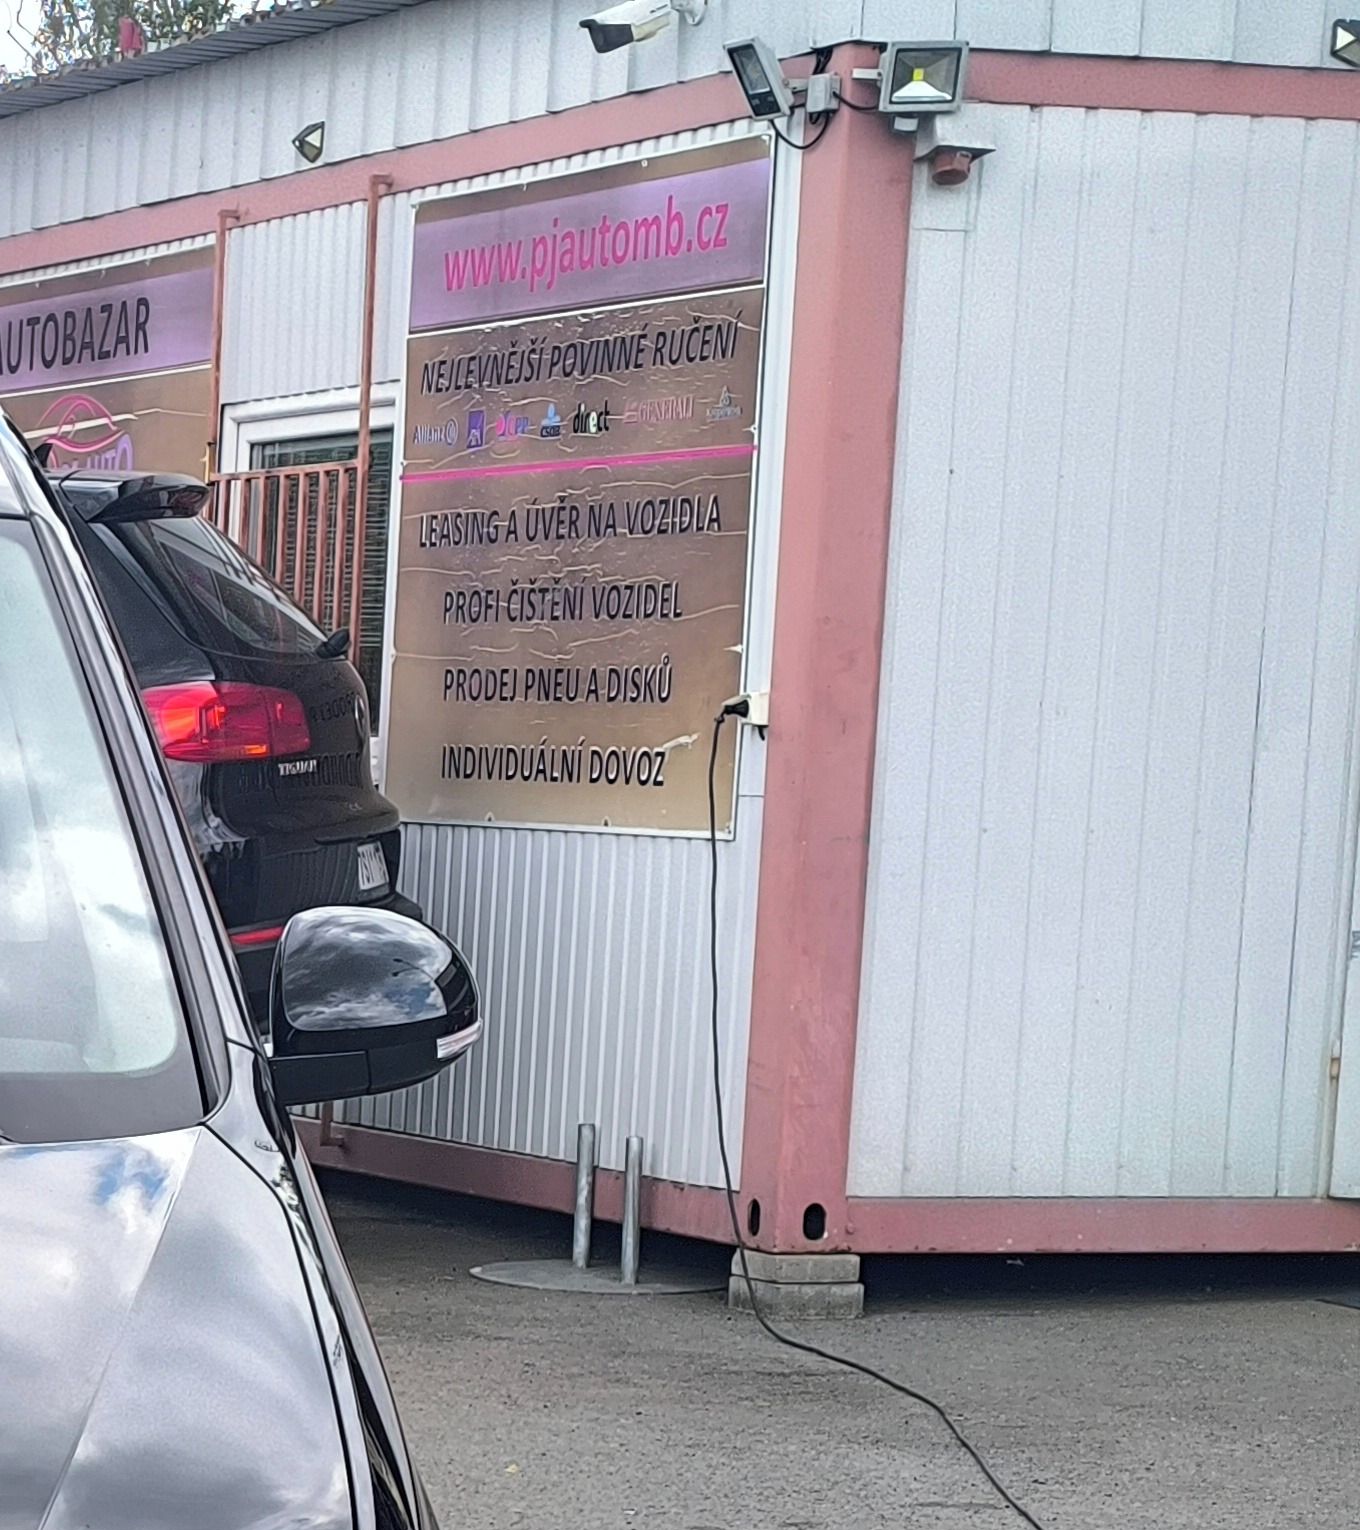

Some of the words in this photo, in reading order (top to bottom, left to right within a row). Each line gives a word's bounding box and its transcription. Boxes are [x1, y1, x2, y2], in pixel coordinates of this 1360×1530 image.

[444, 195, 729, 292] www.pjautomb.cz
[420, 335, 546, 395] NEJLEVNĚJŠÍ
[548, 323, 649, 379] POVINNÉ
[653, 310, 743, 366] RUČENÍ
[573, 400, 610, 434] direct
[419, 510, 500, 549] LEASING
[505, 512, 519, 544] A
[526, 497, 579, 541] ÚVĚR
[587, 501, 618, 538] NA
[625, 495, 722, 535] VOZIDLA
[443, 588, 500, 625] PROFI
[507, 577, 588, 623] ČIŠTĚNÍ
[591, 582, 683, 621] VOZIDEL
[444, 667, 517, 703] PRODEJ
[524, 666, 579, 702] PNEU
[585, 667, 600, 702] A
[606, 653, 673, 702] DISKŮ
[441, 737, 587, 783] INDIVIDUÁLNÍ
[589, 745, 666, 787] DOVOZ
